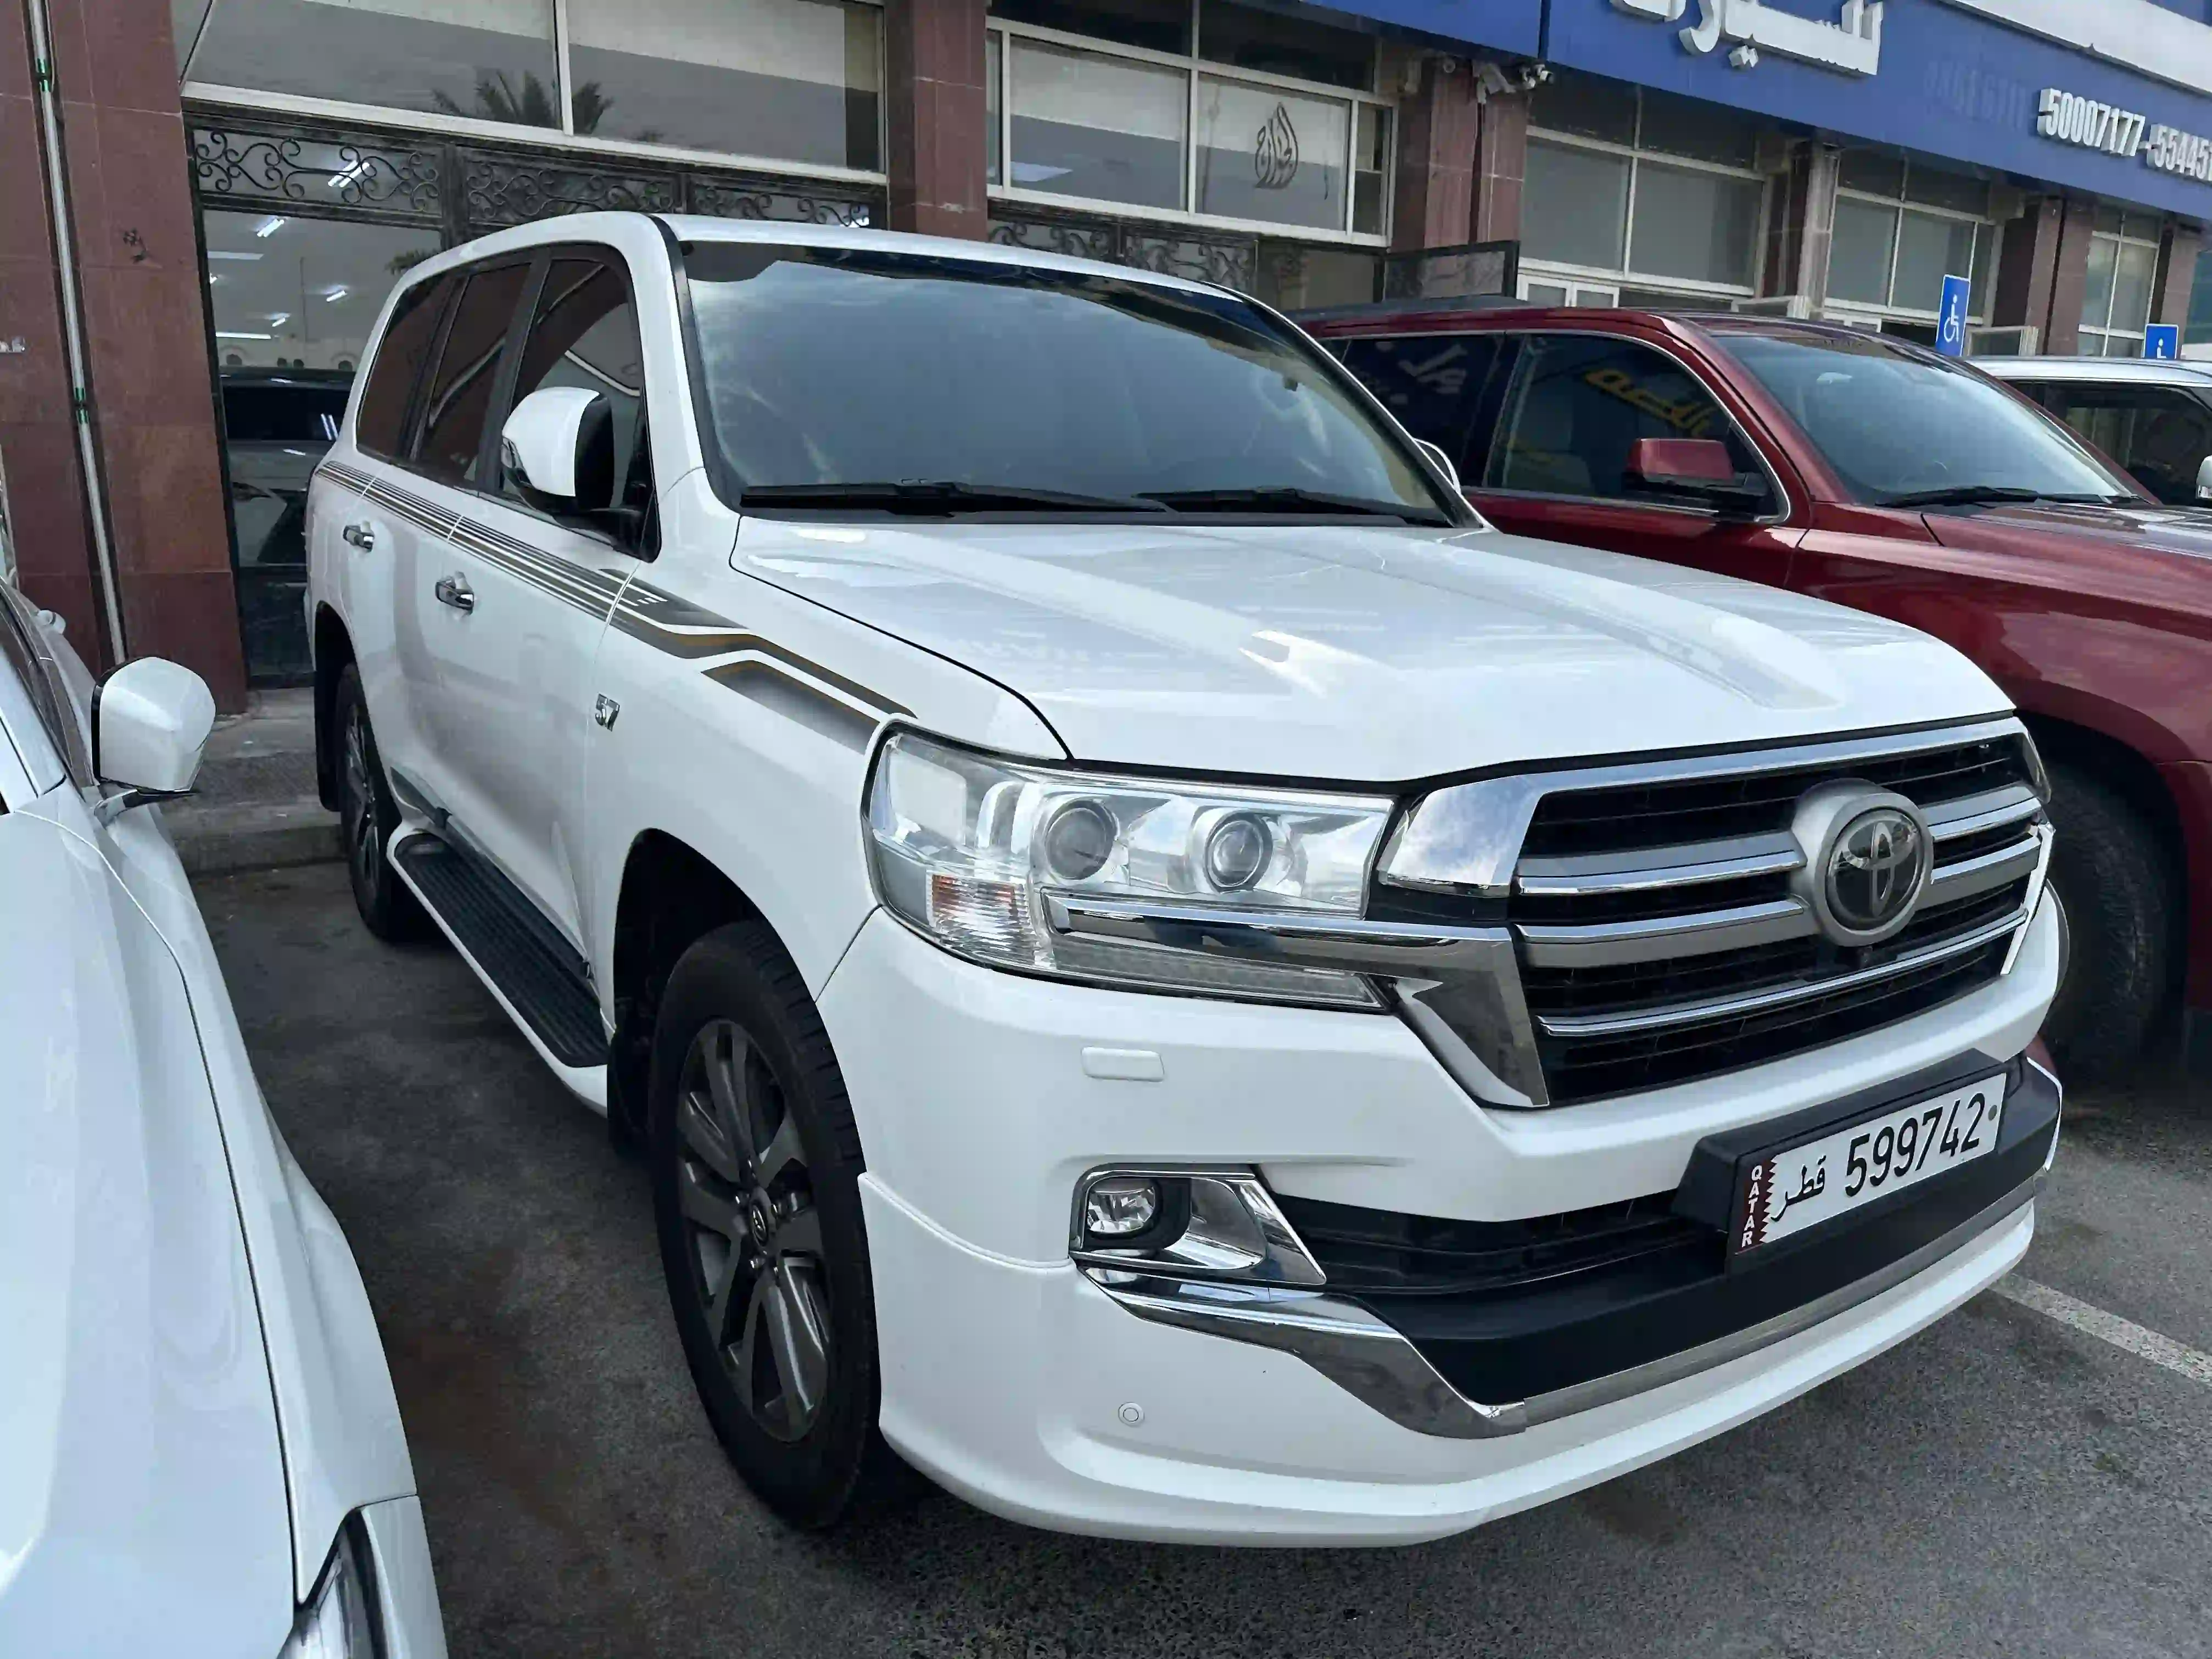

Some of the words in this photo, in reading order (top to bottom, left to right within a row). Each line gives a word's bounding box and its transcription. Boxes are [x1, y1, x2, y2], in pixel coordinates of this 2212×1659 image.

[1741, 1164, 1763, 1248] QATAR
[1770, 1155, 1827, 1222] قطر
[1844, 1092, 1986, 1197] 599742
